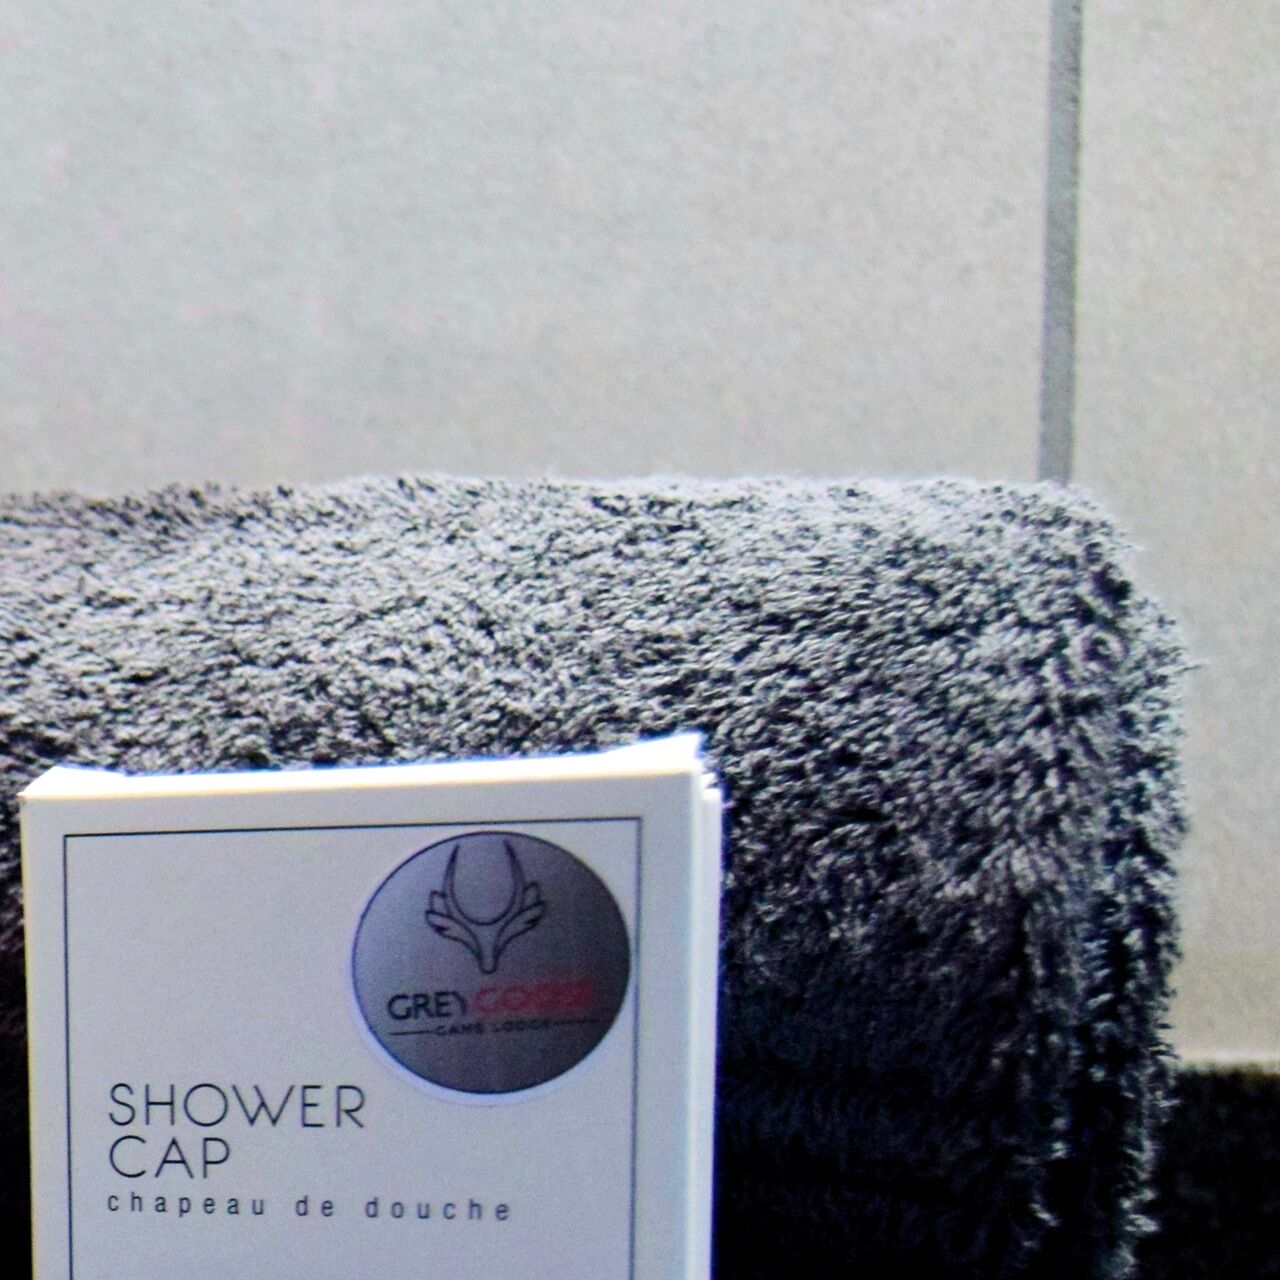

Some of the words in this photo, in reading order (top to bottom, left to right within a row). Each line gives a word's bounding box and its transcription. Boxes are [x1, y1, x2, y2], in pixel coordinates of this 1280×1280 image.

[387, 990, 468, 1020] GREY
[108, 1082, 366, 1129] SHOWER
[108, 1134, 231, 1179] CAP
[107, 1192, 265, 1218] chapeau
[295, 1194, 334, 1217] de
[365, 1197, 510, 1222] douche
